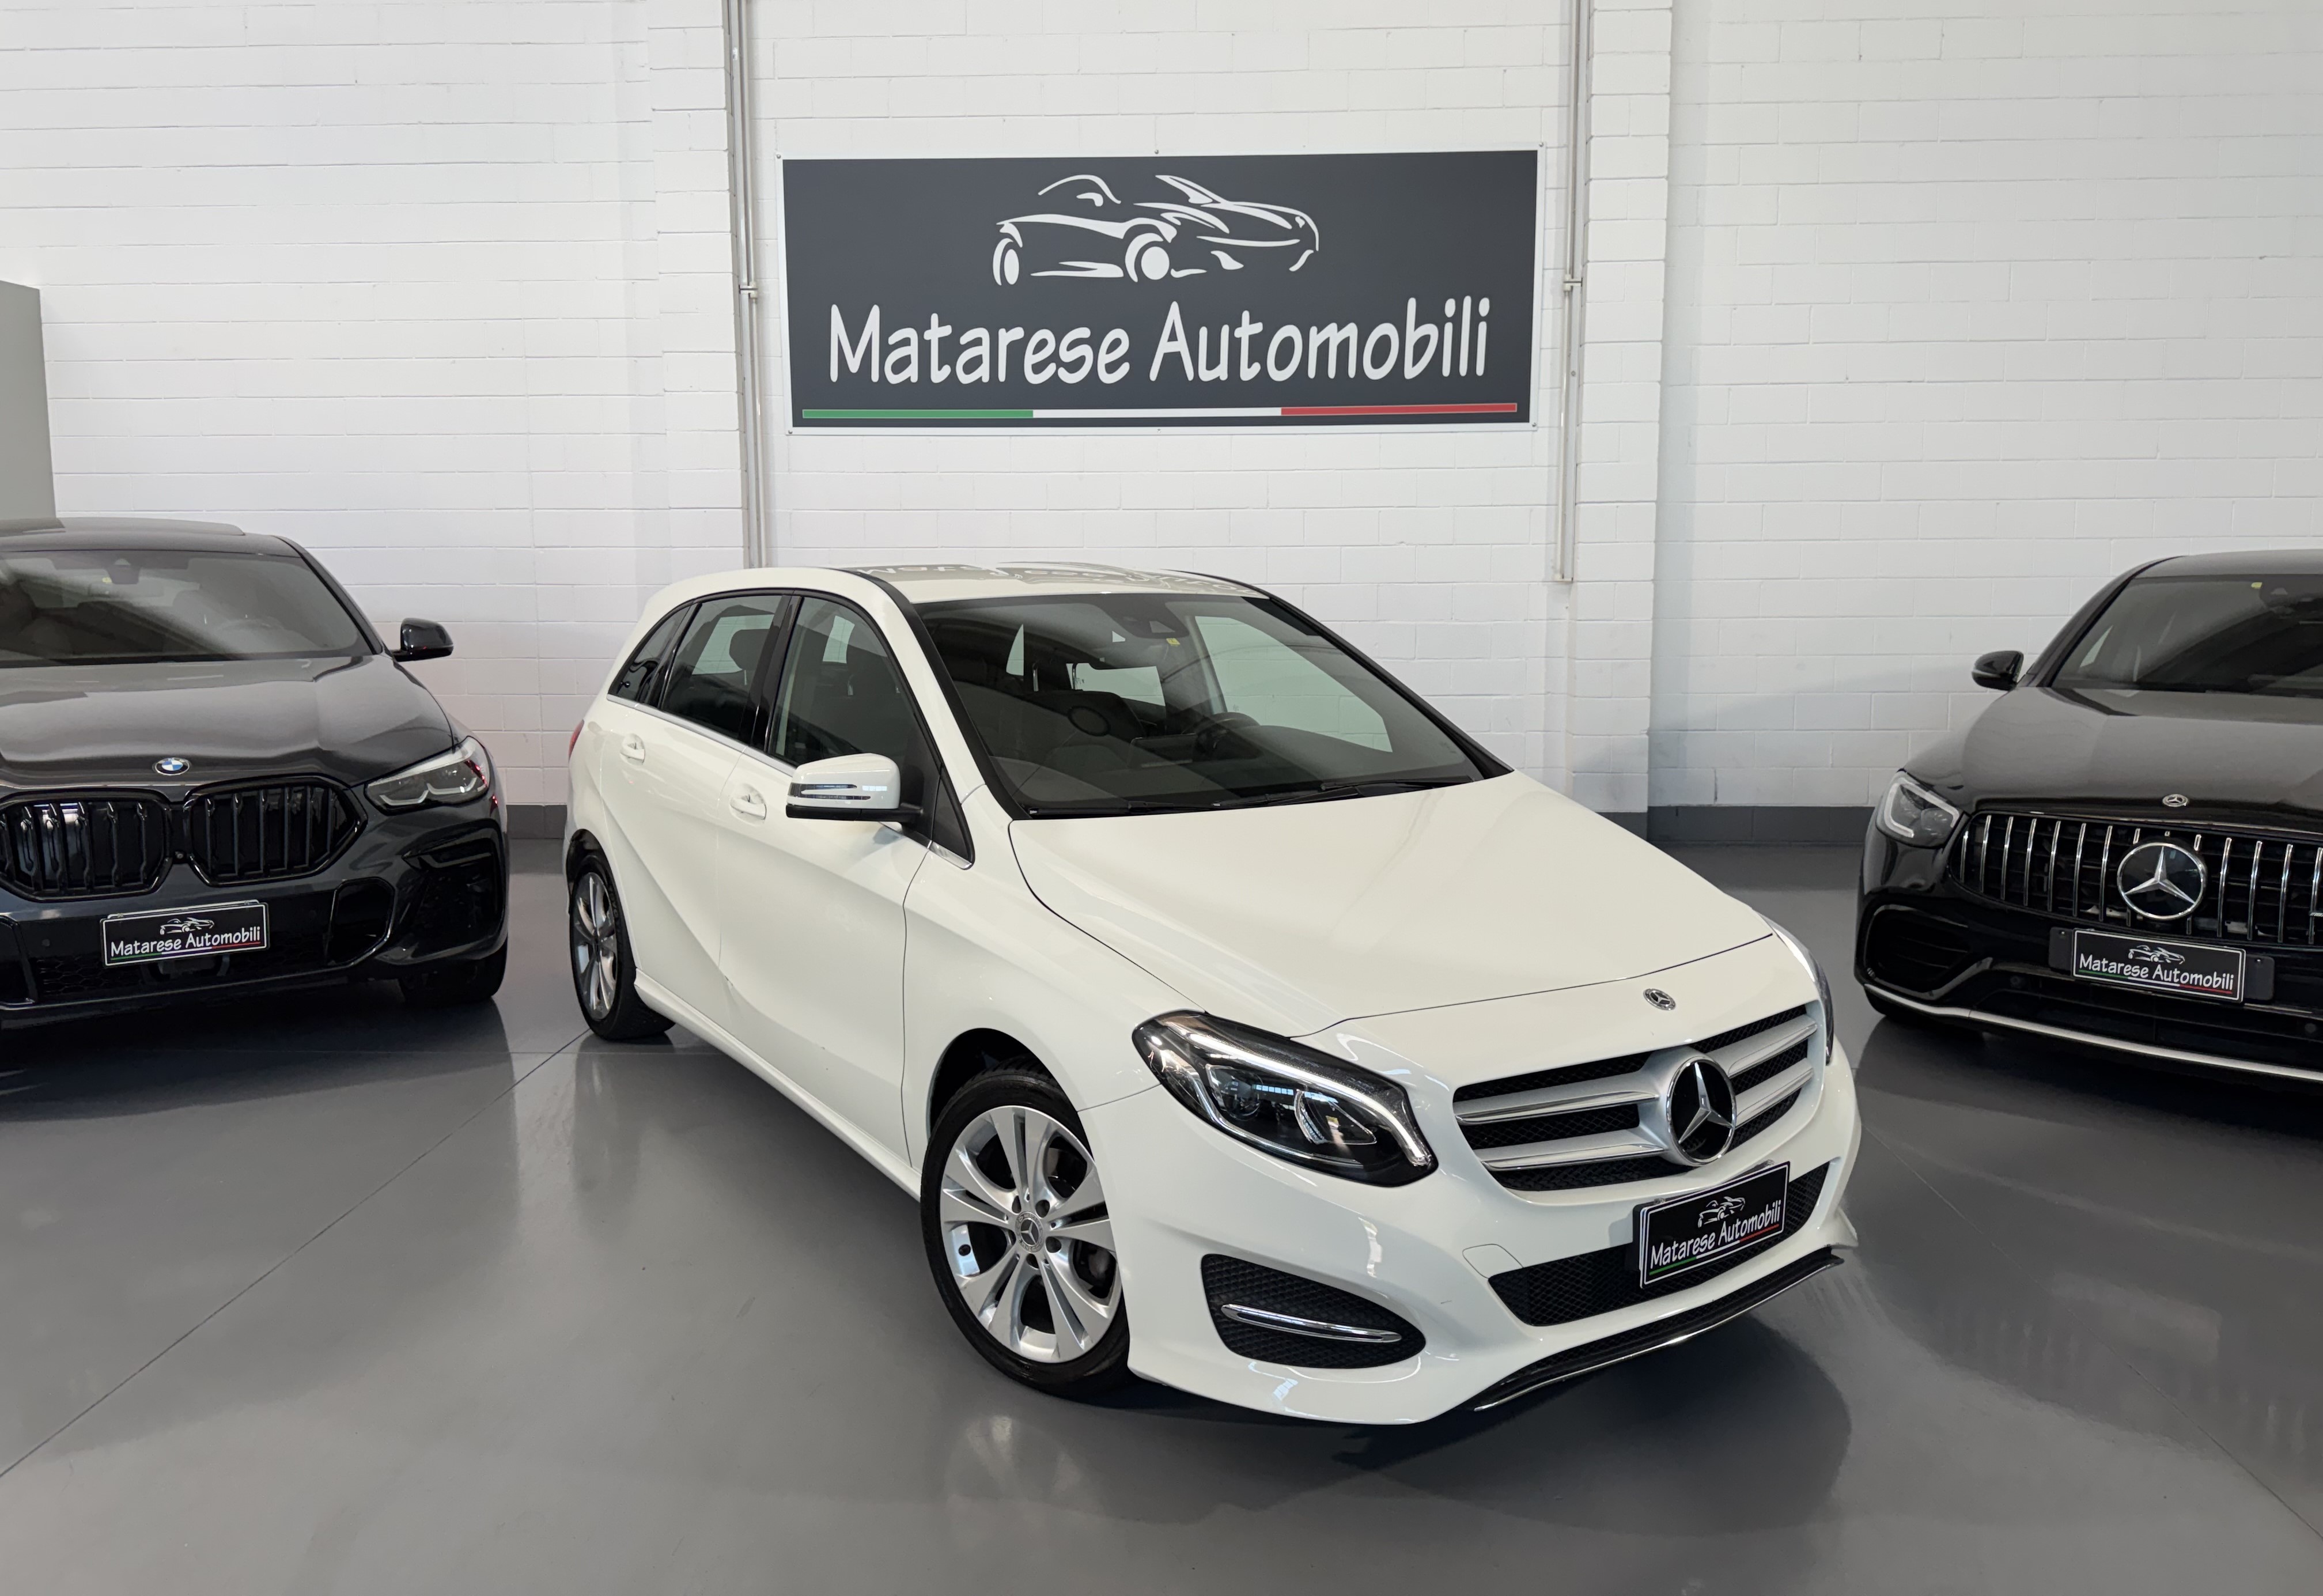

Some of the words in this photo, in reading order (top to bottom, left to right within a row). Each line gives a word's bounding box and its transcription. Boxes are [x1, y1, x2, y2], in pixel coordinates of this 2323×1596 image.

[830, 304, 1130, 384] Matarese
[1149, 296, 1490, 382] Automobili
[111, 939, 181, 957] Matarese
[185, 925, 260, 948] Automobili
[2079, 953, 2149, 978] Matarese
[2152, 964, 2234, 990] Automobili
[1650, 1232, 1716, 1269] Matarese
[1717, 1200, 1781, 1246] Automobili
